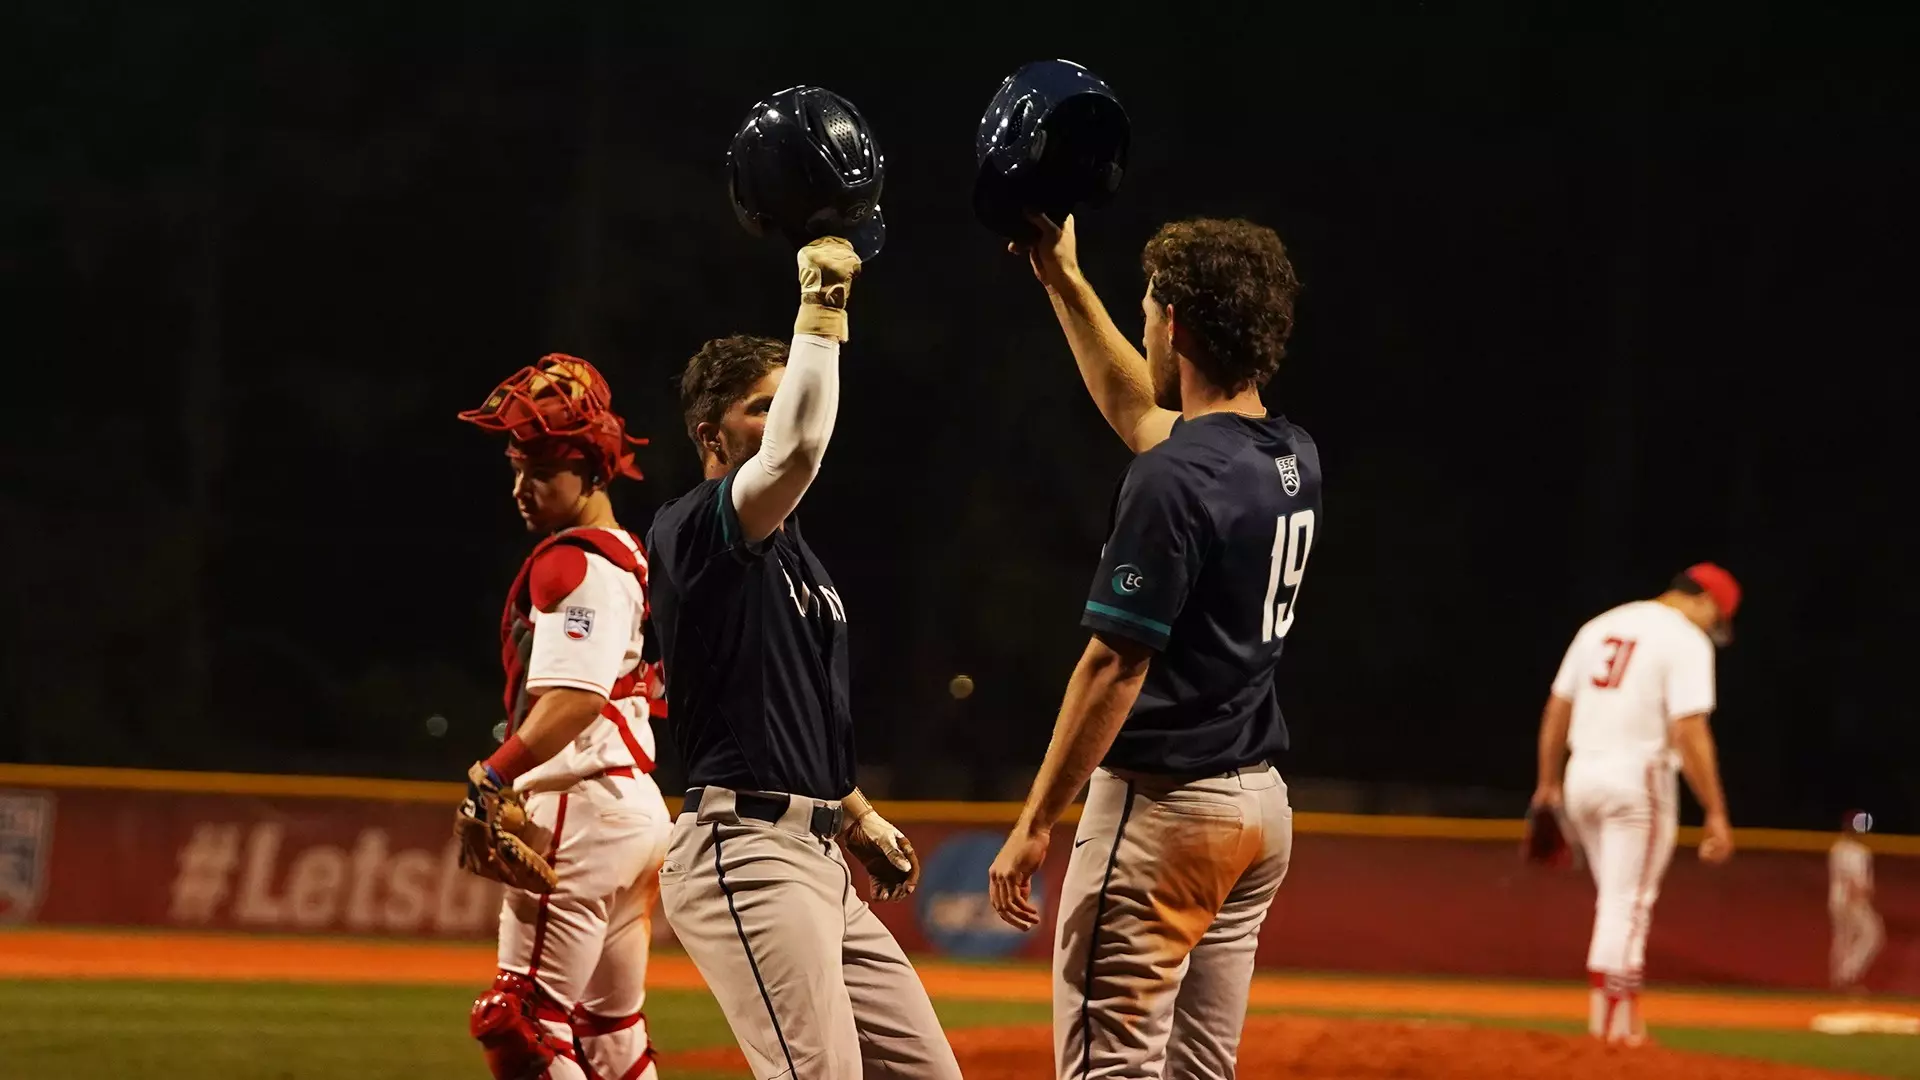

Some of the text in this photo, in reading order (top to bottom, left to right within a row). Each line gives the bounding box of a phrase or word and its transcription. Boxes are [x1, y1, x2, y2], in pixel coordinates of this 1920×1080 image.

[1126, 572, 1143, 588] EC
[1262, 509, 1315, 643] 19
[1591, 637, 1637, 688] 31
